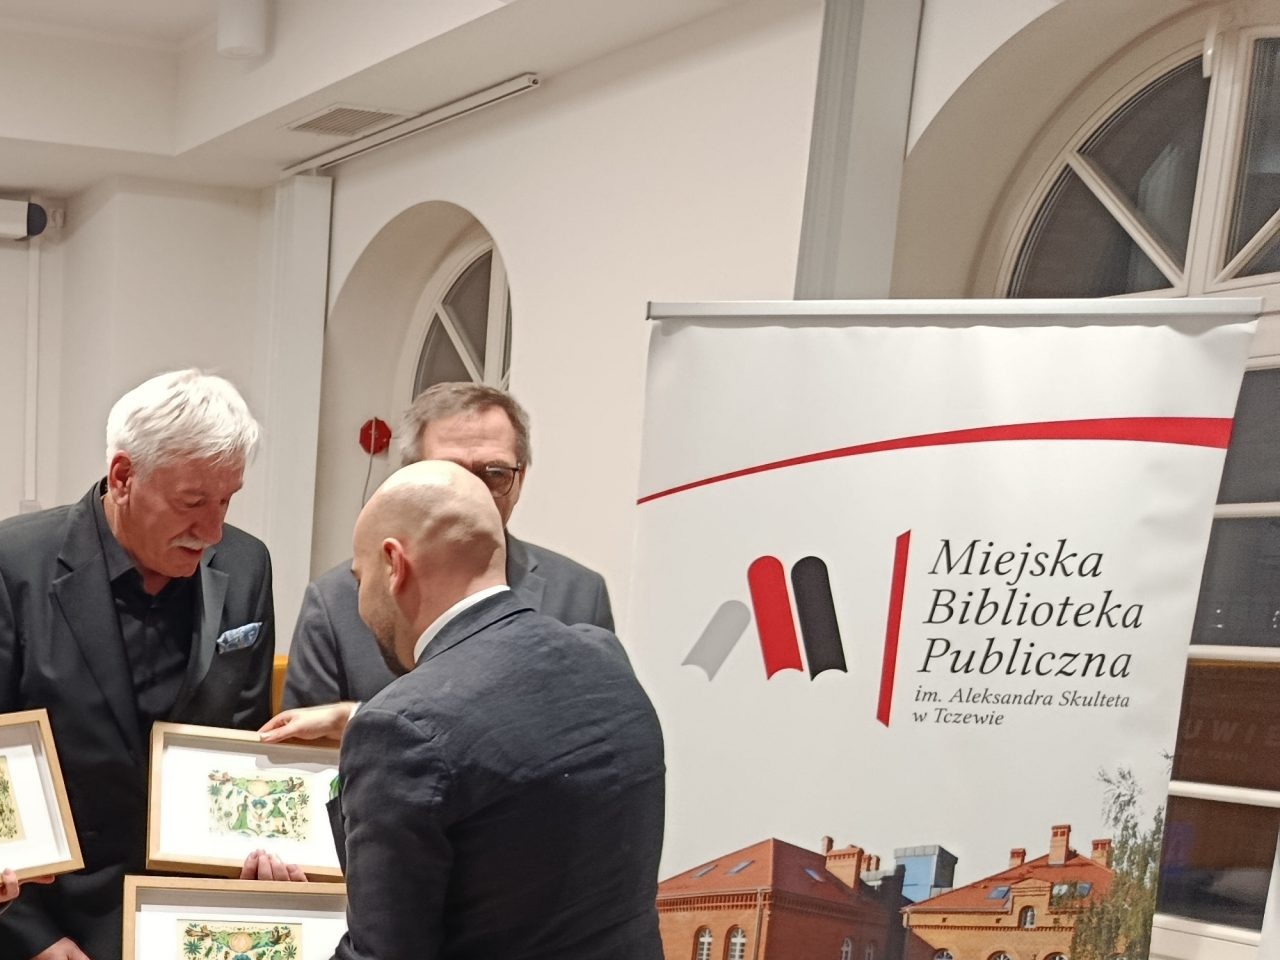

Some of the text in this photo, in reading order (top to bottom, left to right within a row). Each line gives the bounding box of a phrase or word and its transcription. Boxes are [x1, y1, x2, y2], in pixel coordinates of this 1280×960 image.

[927, 537, 1104, 587] Miejska
[921, 586, 1144, 629] Biblioteka
[916, 636, 1133, 679] Publiczna
[912, 707, 1006, 726] w Tczewie
[914, 684, 1130, 708] im. Aleksandra Skulteta
